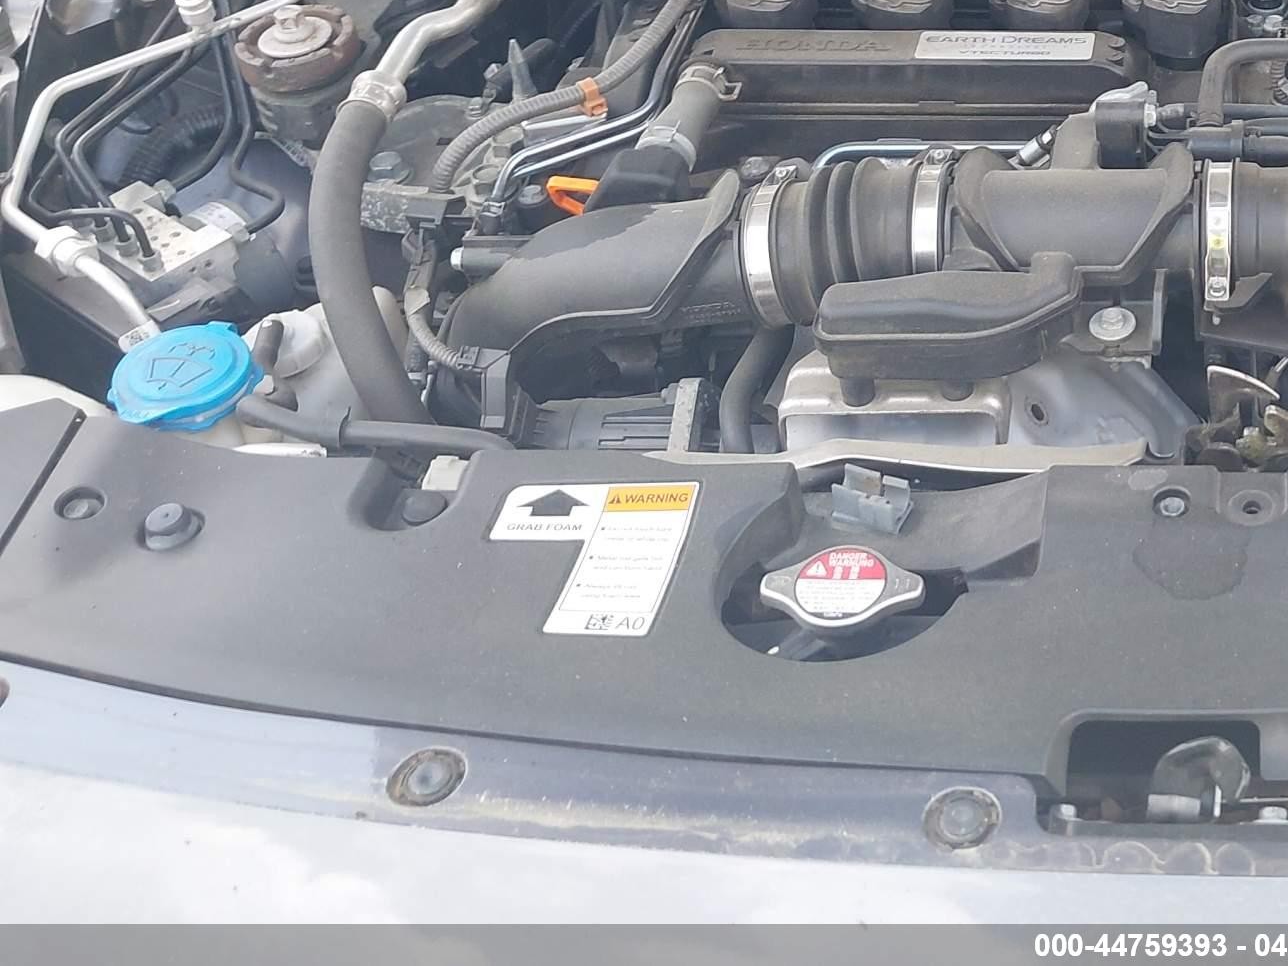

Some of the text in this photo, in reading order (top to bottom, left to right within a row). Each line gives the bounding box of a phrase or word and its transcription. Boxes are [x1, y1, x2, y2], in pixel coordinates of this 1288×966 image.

[925, 35, 1088, 44] EARTH DREAMS
[735, 39, 891, 52] HONDA
[624, 492, 689, 504] WARNING
[506, 522, 583, 531] GRAB FOAM
